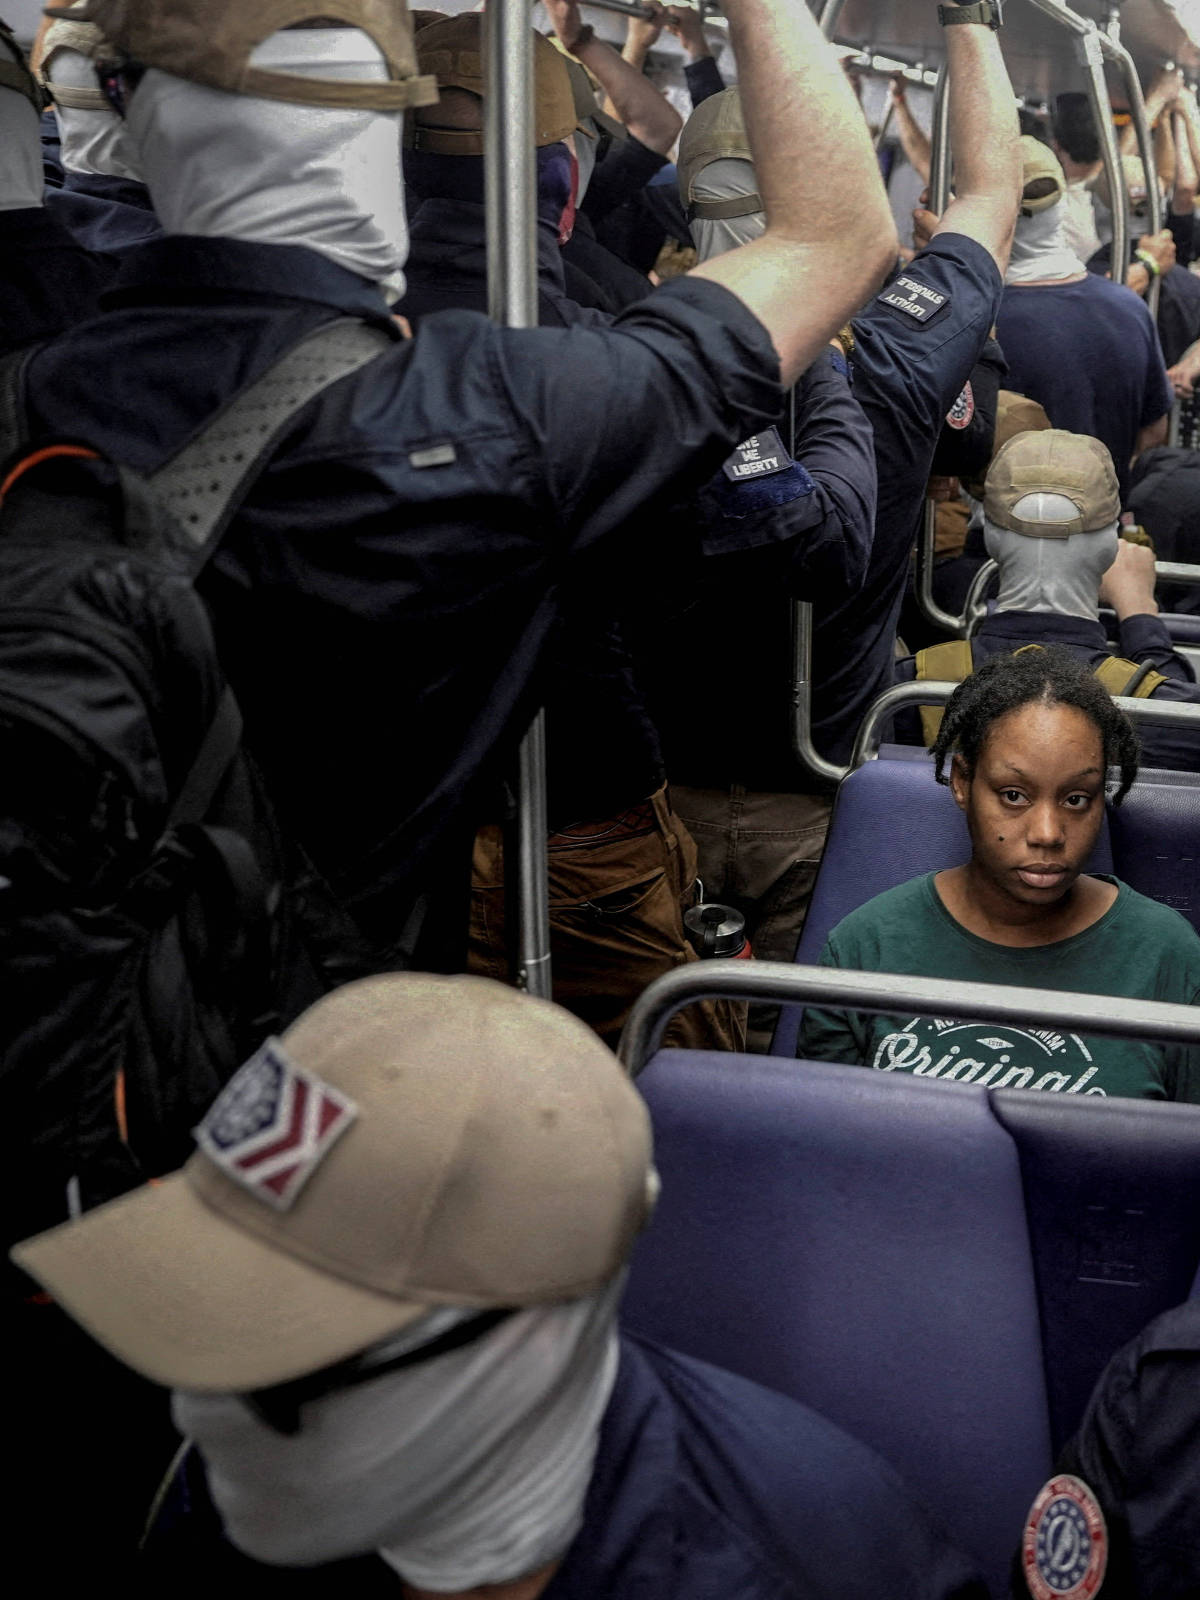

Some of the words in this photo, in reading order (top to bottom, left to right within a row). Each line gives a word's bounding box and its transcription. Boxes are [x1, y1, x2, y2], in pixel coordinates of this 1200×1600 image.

[897, 277, 945, 304] STRUGGLE
[884, 293, 926, 316] LOYALTY
[732, 457, 779, 476] LIBERTY
